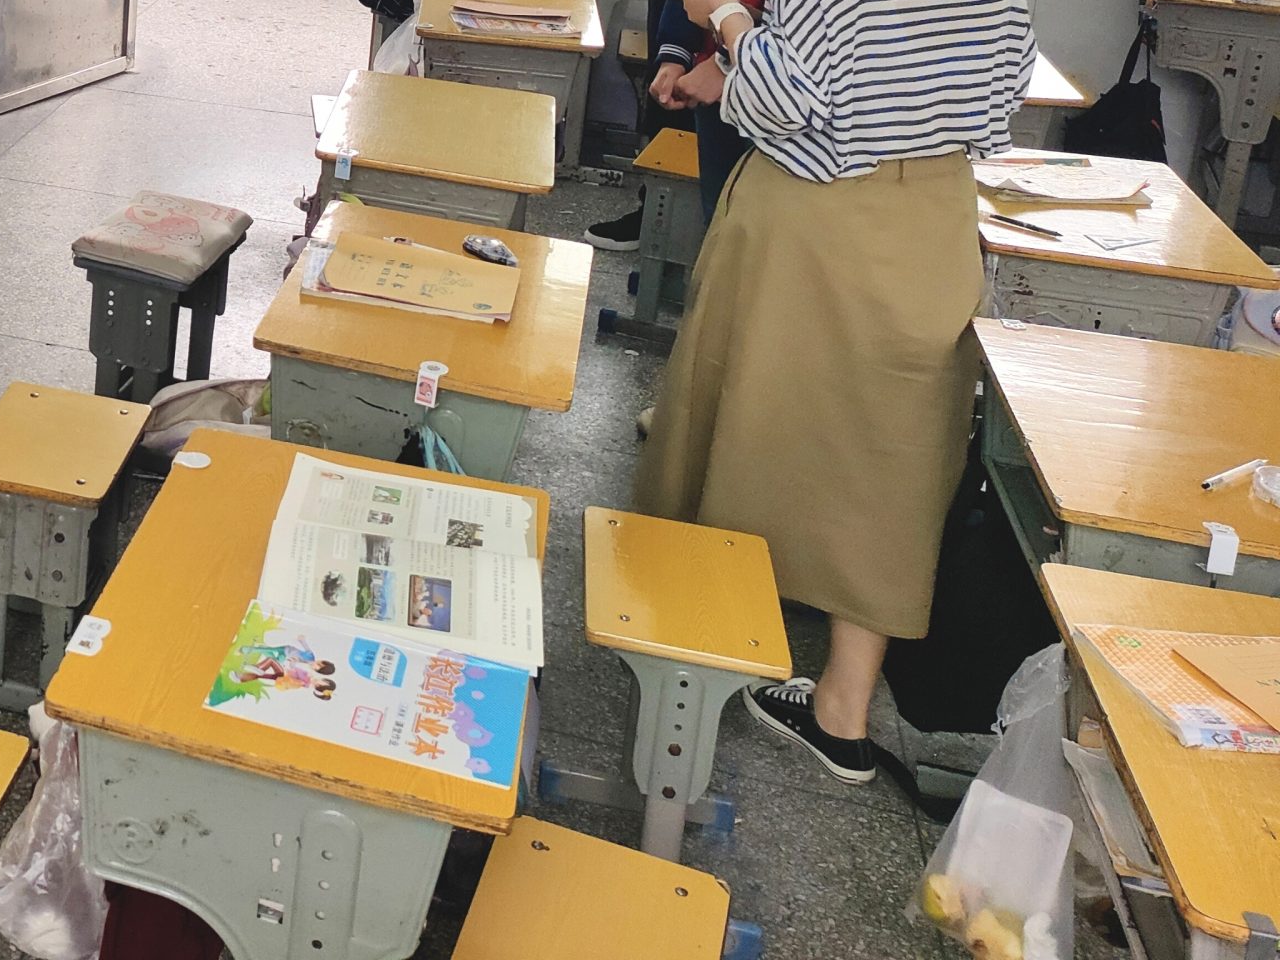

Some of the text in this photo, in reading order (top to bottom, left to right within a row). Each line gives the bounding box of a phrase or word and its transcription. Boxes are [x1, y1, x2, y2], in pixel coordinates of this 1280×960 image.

[404, 655, 466, 761] 长江作业本
